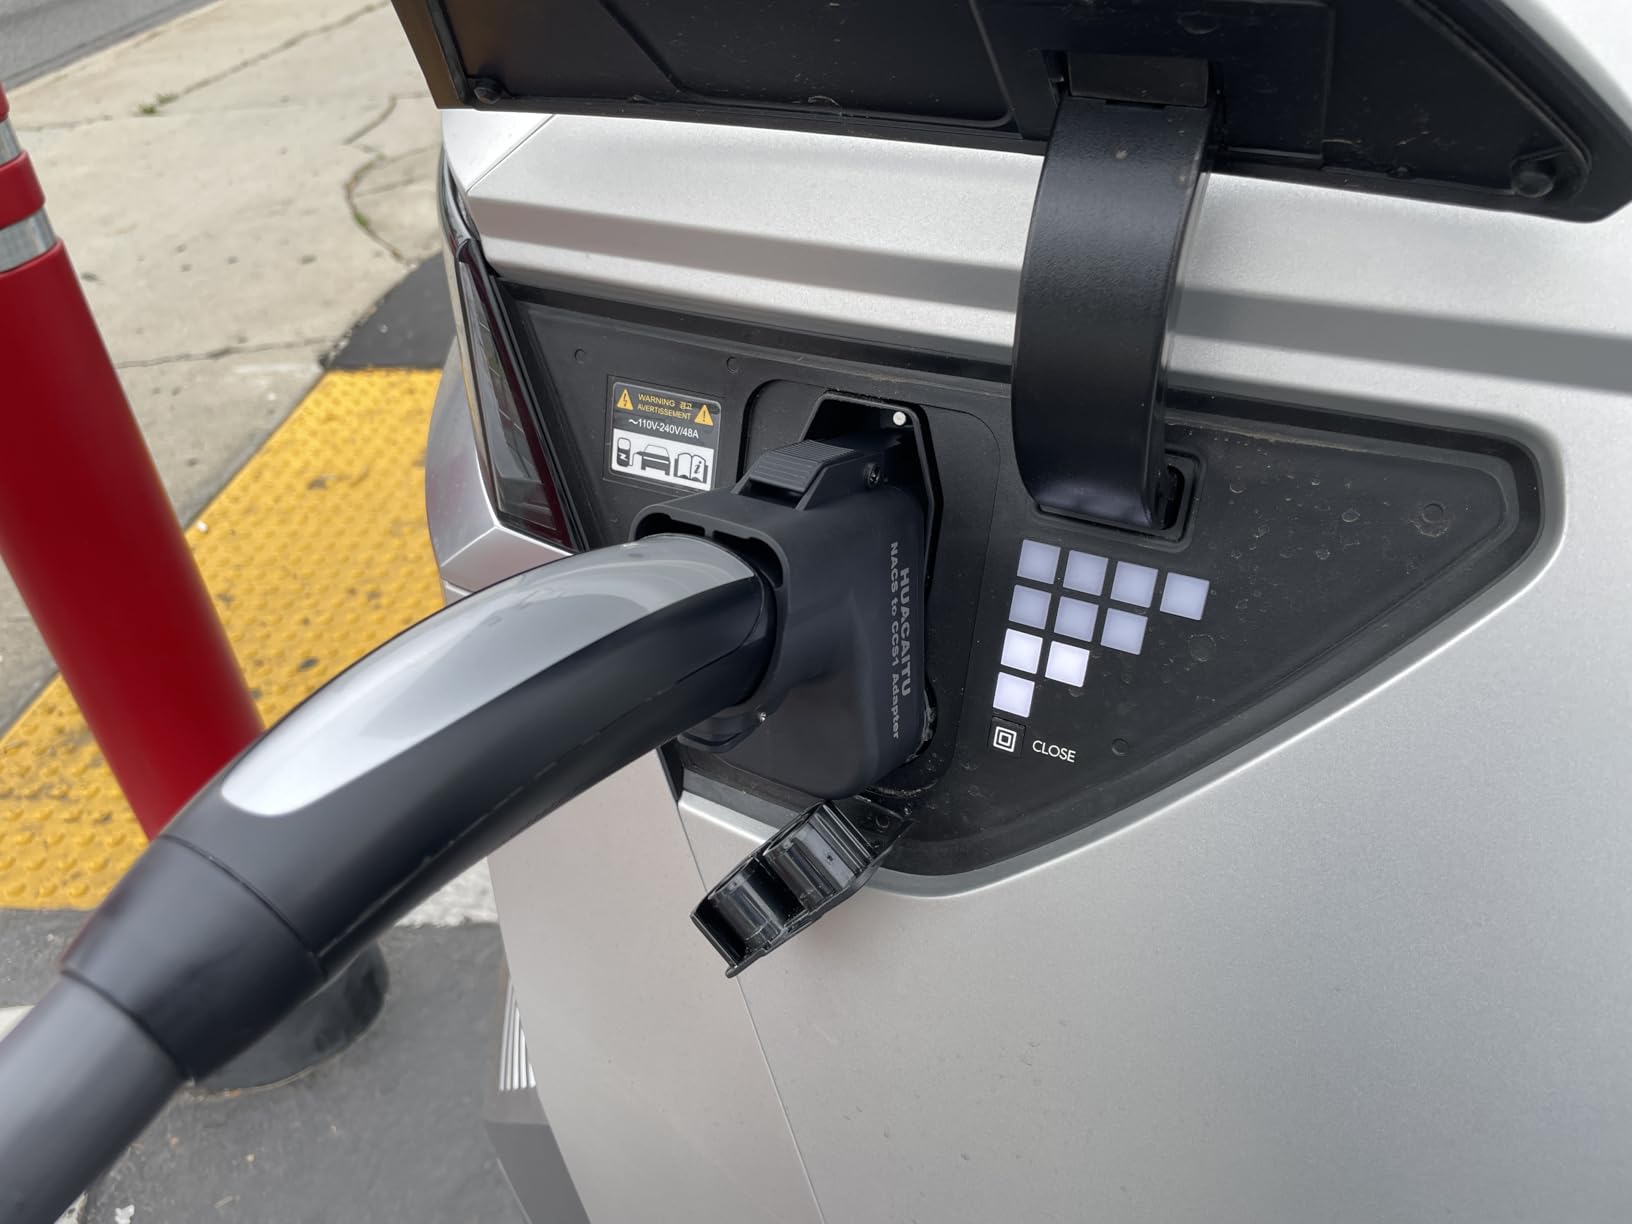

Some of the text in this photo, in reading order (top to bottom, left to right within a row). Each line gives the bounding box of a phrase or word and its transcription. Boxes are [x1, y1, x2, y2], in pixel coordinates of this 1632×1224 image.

[638, 394, 675, 406] WARNING
[638, 404, 691, 420] AVERTISSEMENT
[890, 542, 900, 739] NACS to CCS1 Adapter
[900, 567, 911, 697] HUACAITU
[1032, 740, 1076, 763] CLOSE
